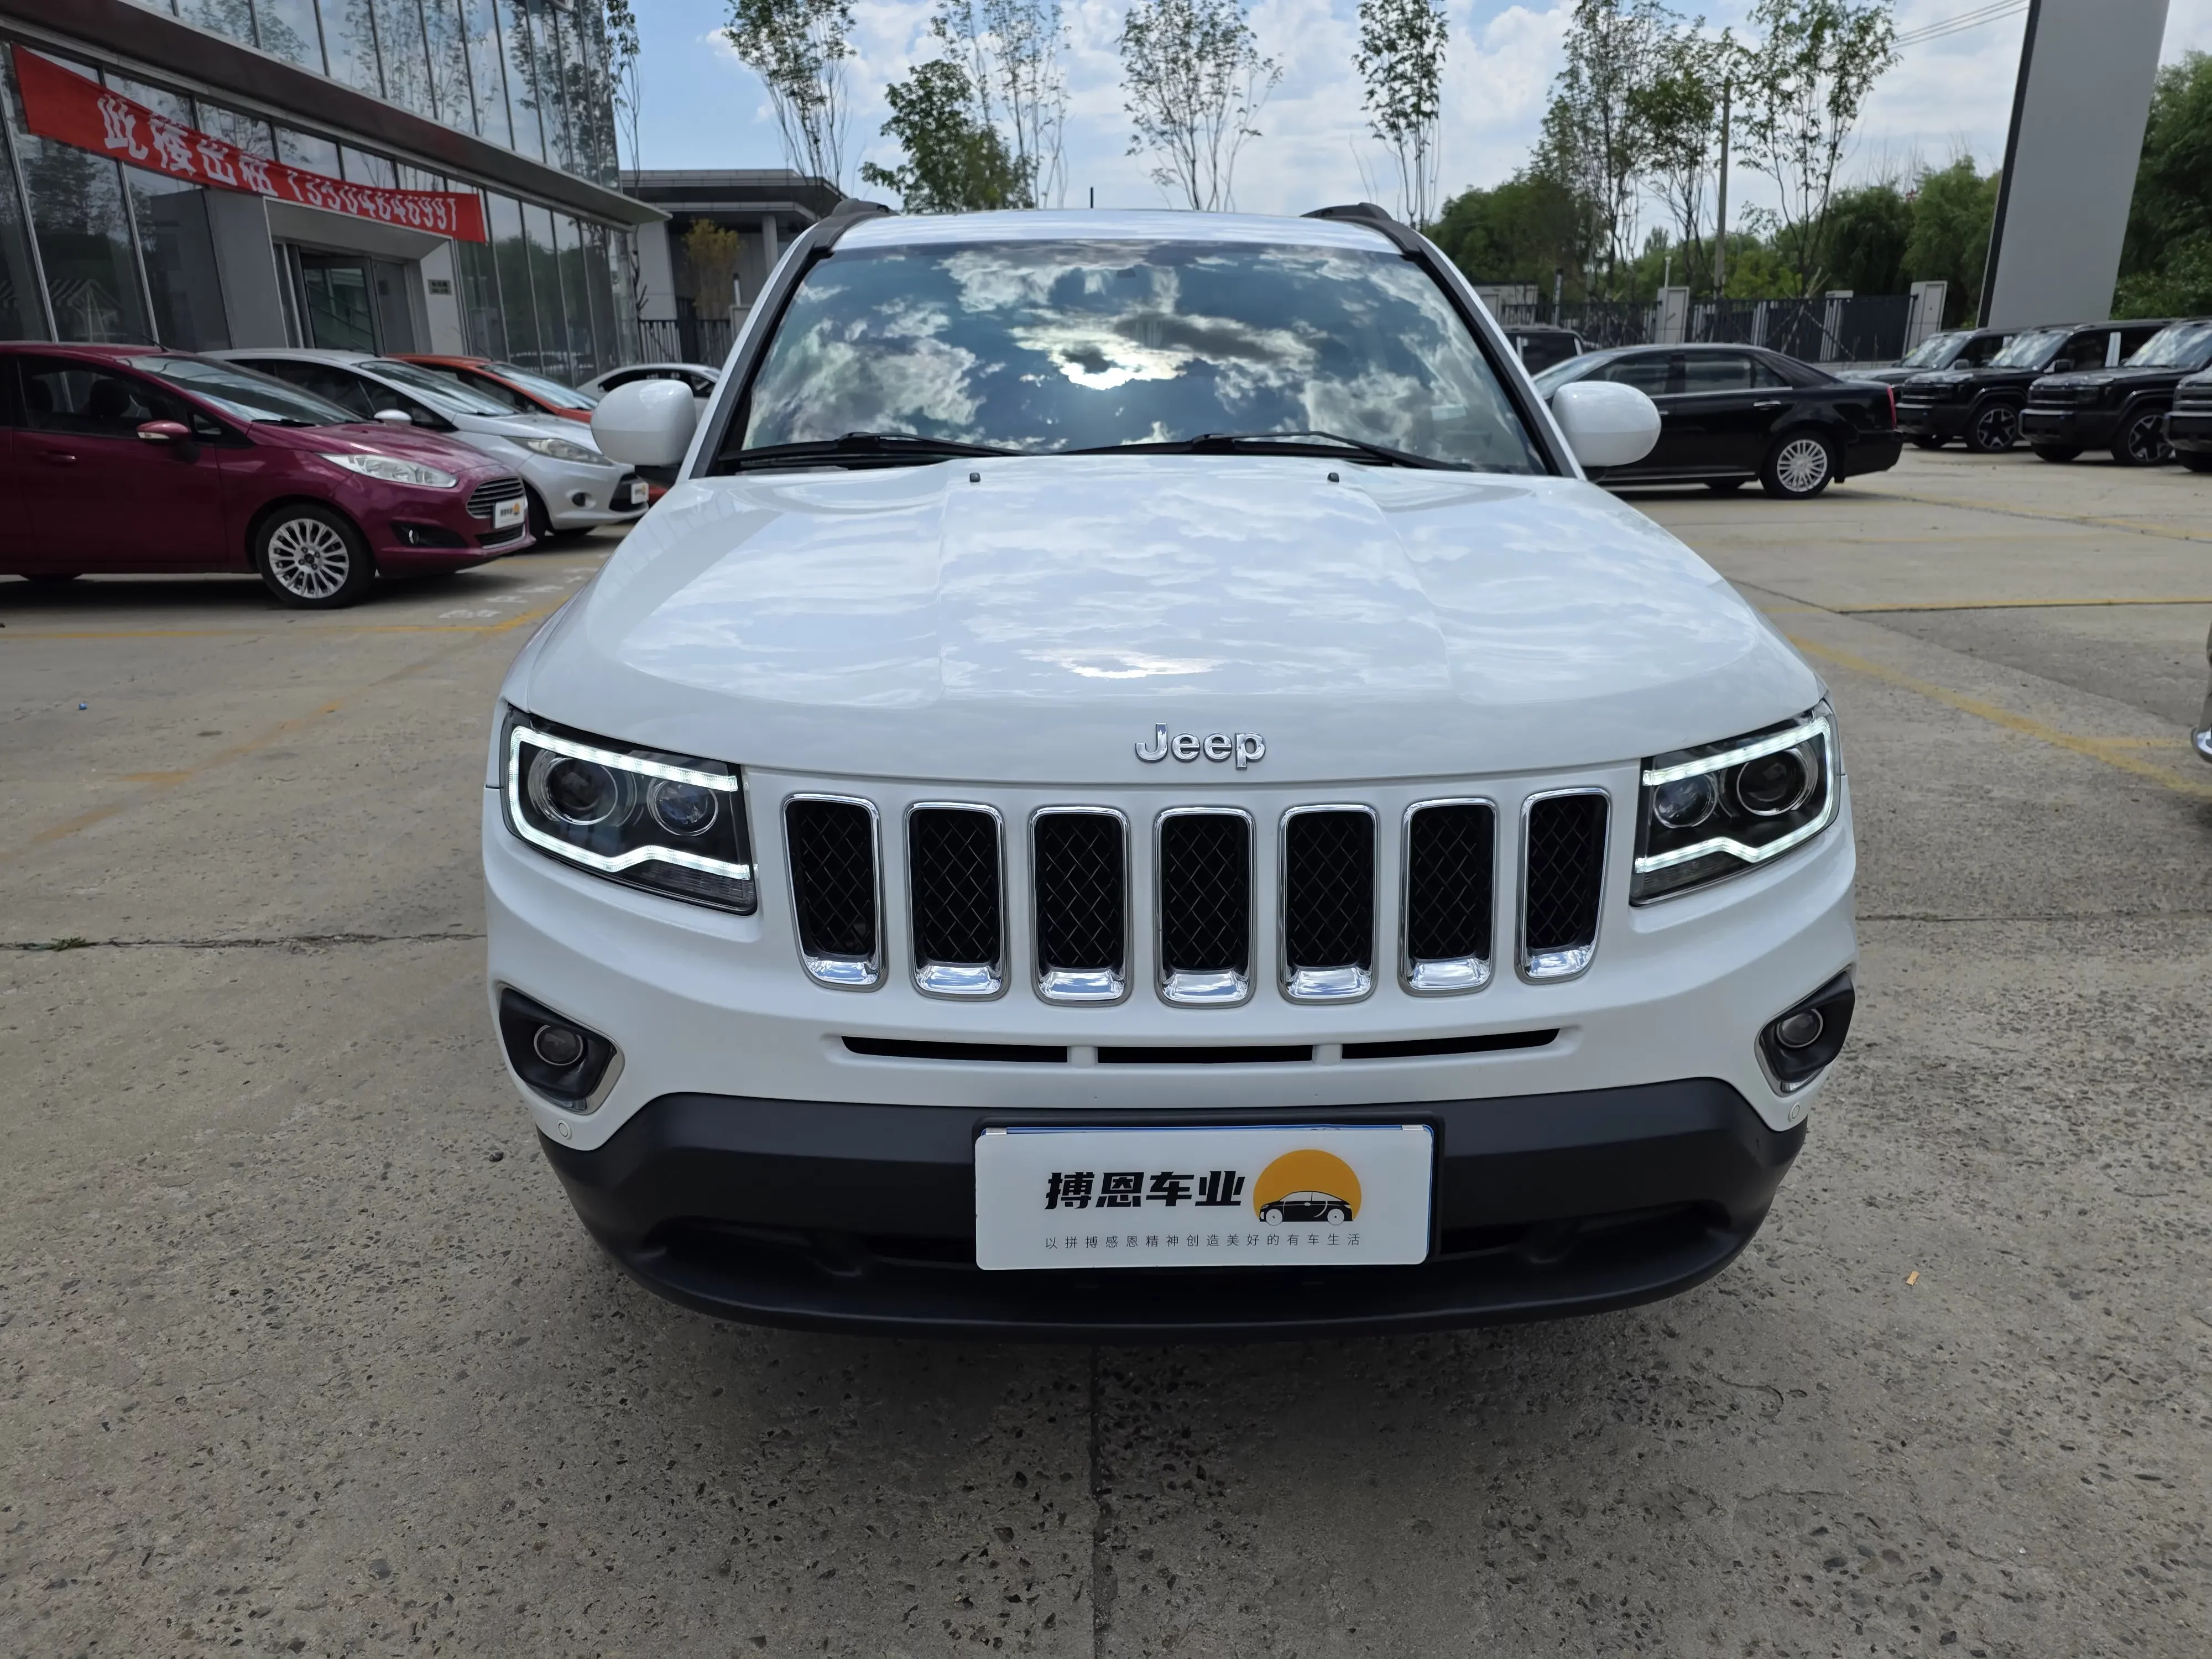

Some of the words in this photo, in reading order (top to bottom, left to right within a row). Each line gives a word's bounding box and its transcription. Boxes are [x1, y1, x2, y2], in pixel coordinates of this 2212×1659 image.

[97, 94, 278, 196] 此楼出租
[1135, 723, 1266, 770] Jeep
[1044, 1171, 1245, 1209] 搏恩车业
[1045, 1233, 1360, 1250] 以拼搏感恩精神创造美好的有车生活
